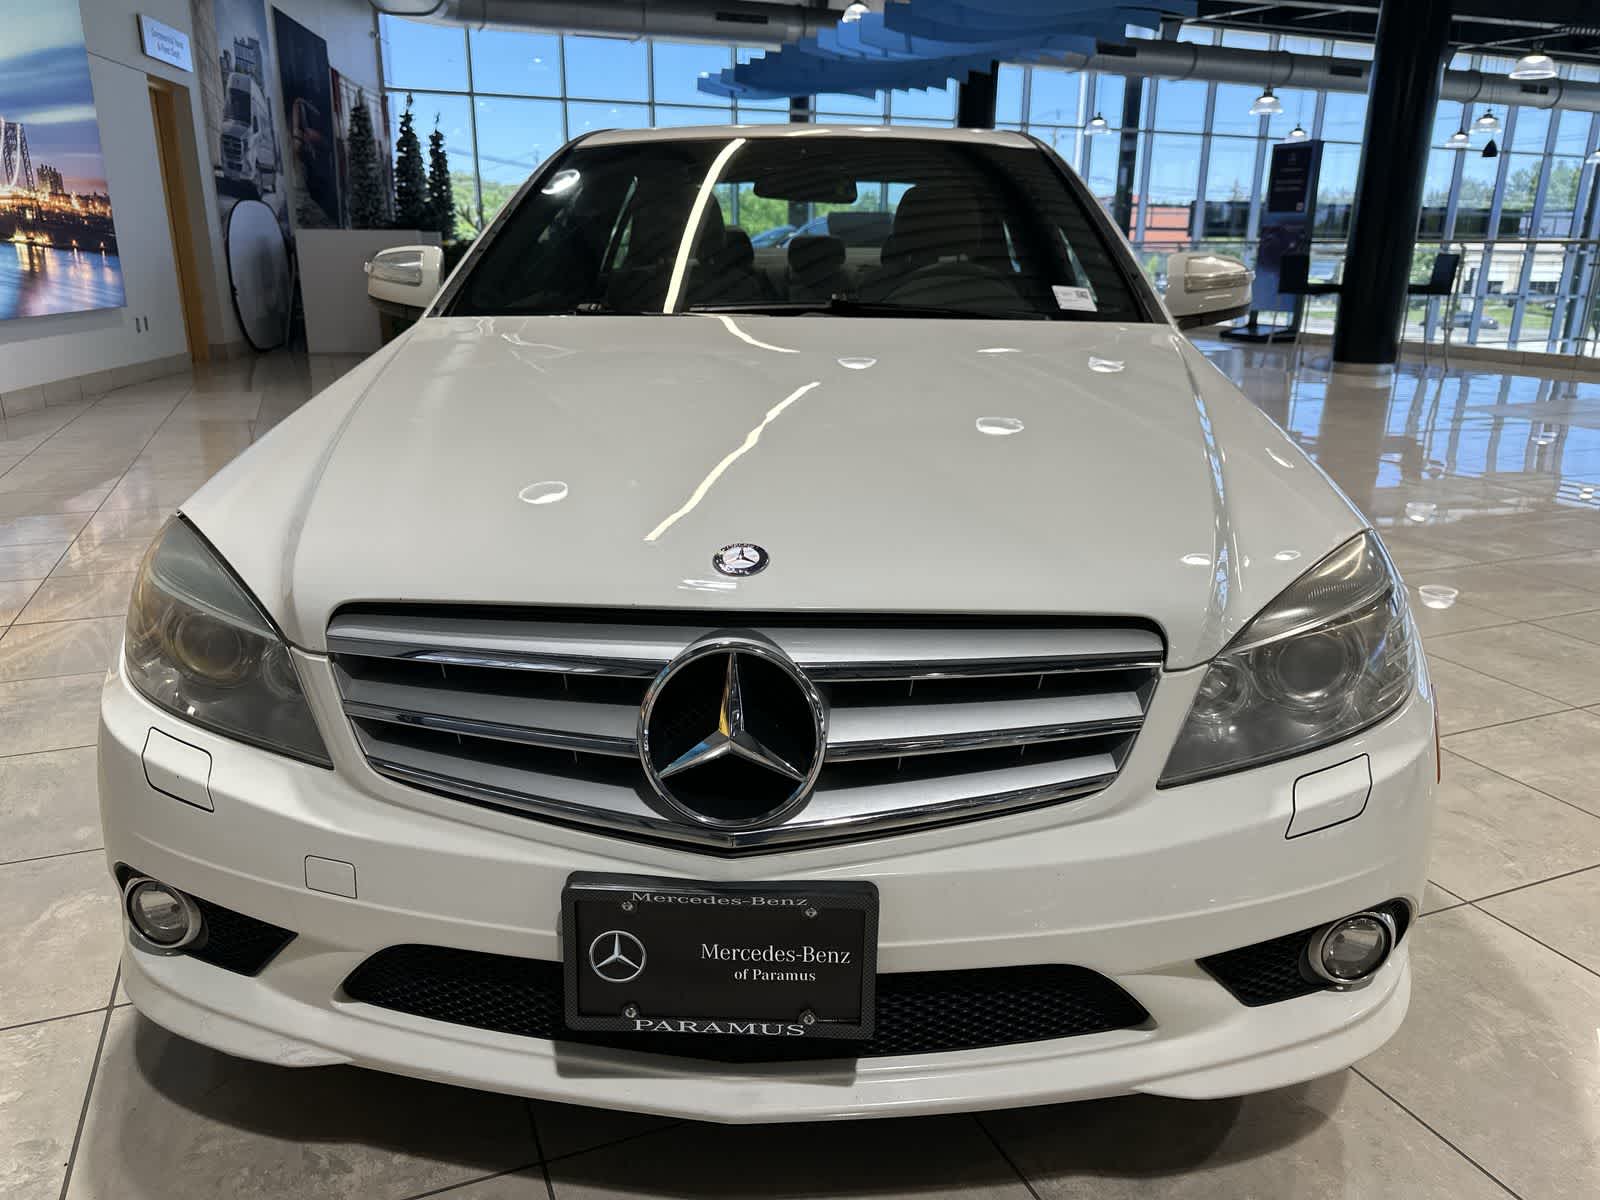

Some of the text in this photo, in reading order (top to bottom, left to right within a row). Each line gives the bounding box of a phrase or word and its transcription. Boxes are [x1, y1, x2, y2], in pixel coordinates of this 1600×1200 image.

[632, 892, 807, 905] Mercedes-Benz
[700, 944, 851, 964] Mercedes-Benz
[734, 969, 816, 981] of Paramus
[632, 1020, 805, 1036] PARAMUS
